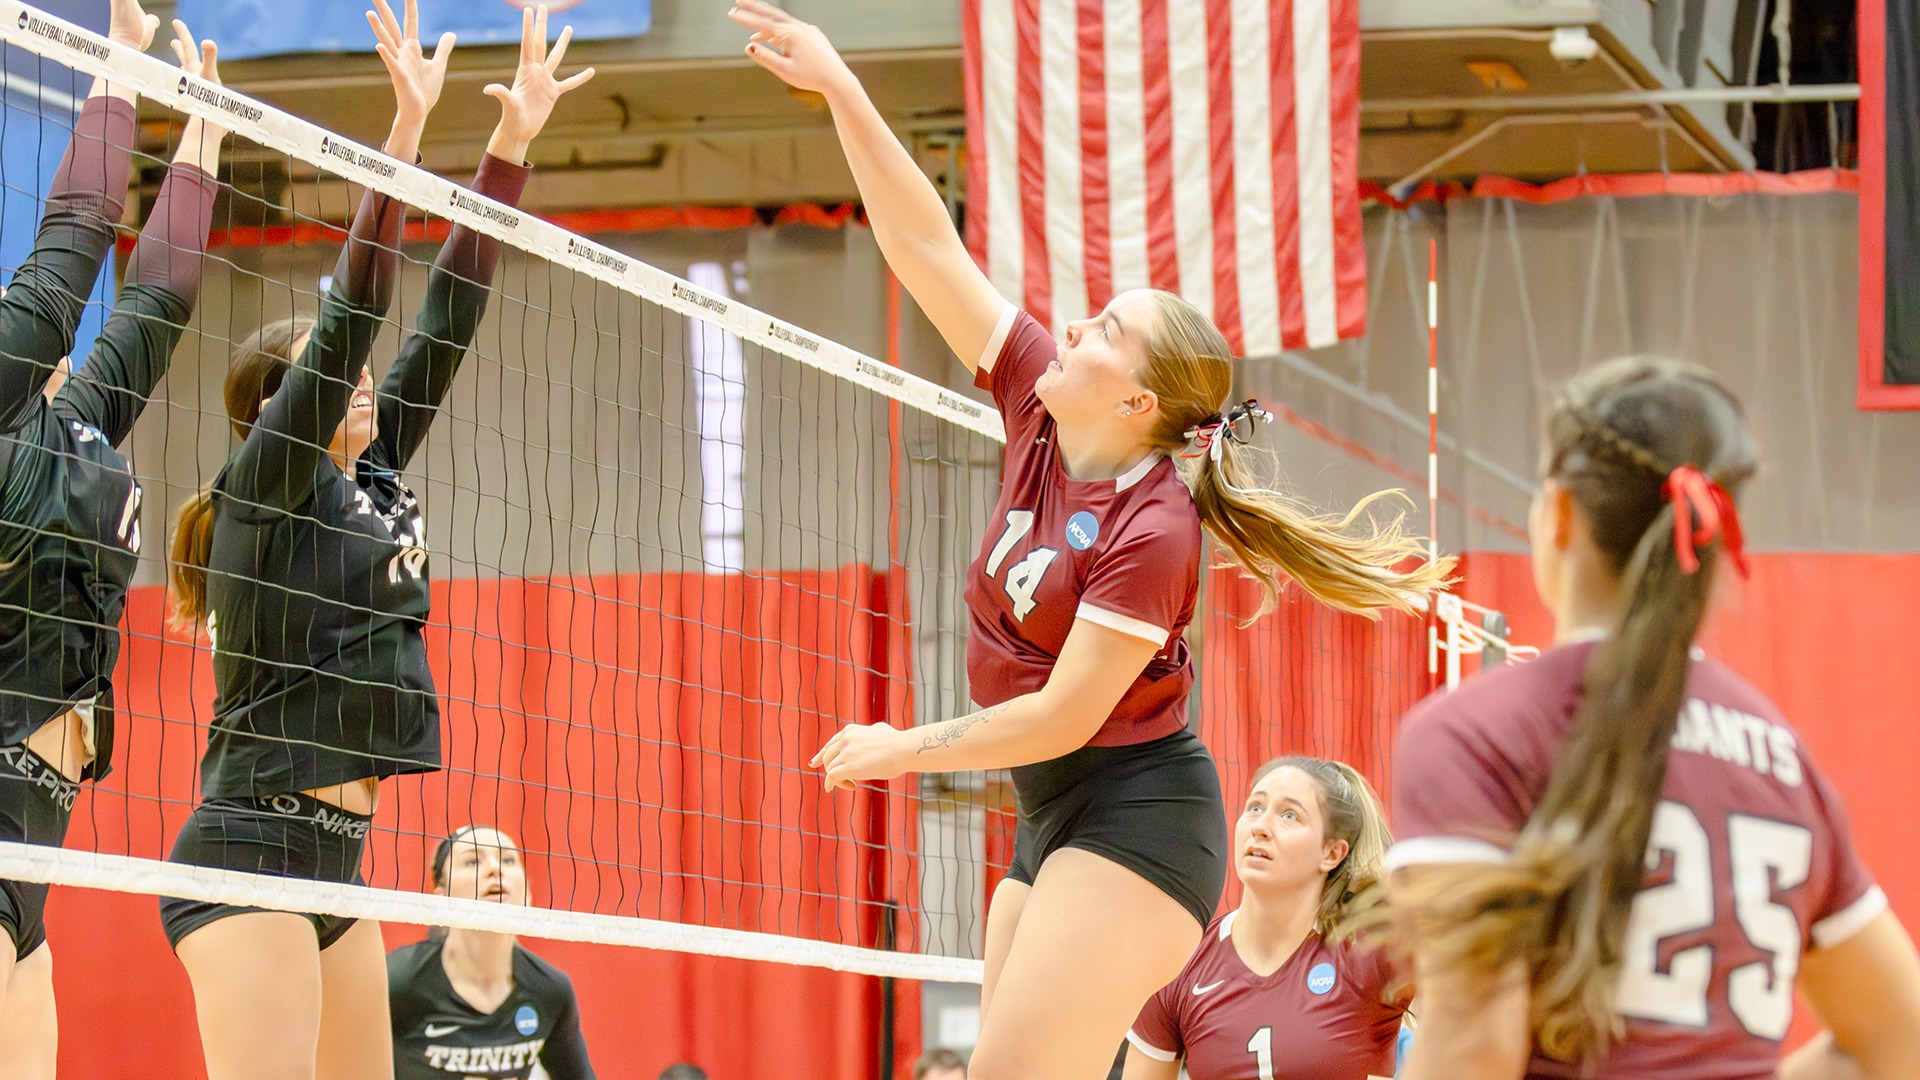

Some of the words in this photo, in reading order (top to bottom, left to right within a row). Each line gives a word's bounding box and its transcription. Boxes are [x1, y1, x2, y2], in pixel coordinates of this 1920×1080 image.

[28, 16, 64, 44] VOLLEYBALL
[64, 31, 110, 62] CHAMPIONSHIP
[187, 81, 220, 107] VOLLEYBALL
[220, 95, 263, 123] CHAMPIONSHIP
[329, 141, 356, 165] VOLLEYBALL
[358, 153, 396, 179] CHAMPIONSHIP
[456, 194, 484, 217] VOLLEYBALL
[483, 204, 519, 229] CHAMPIONSHIP
[1067, 520, 1092, 549] NCAA
[985, 508, 1061, 623] 14
[37, 768, 78, 812] PRO
[315, 807, 371, 839] NIKE
[1612, 800, 1812, 1040] 25
[1311, 975, 1335, 988] NCAA
[424, 1038, 546, 1073] TRINITY
[1247, 1026, 1274, 1080] 1
